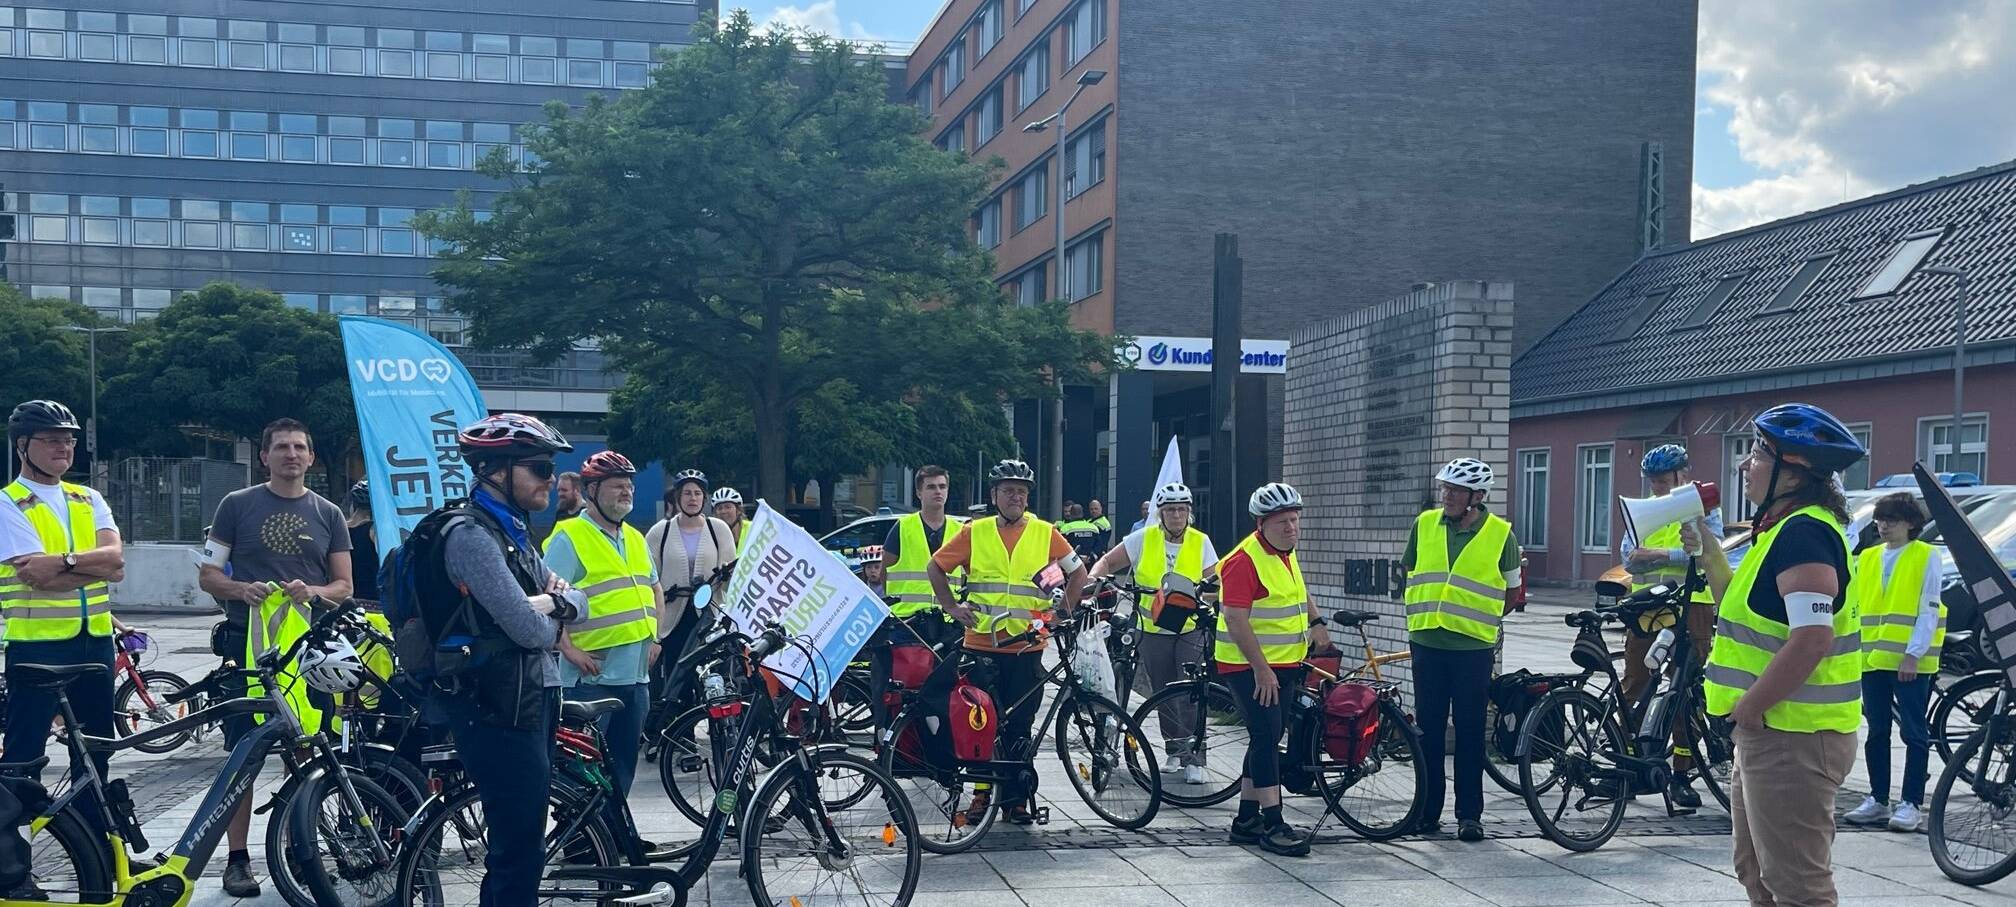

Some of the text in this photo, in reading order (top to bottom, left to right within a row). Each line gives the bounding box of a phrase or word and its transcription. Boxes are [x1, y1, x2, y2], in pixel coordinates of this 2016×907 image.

[355, 358, 418, 383] VCD
[386, 445, 434, 518] JET
[430, 409, 474, 502] VERKE
